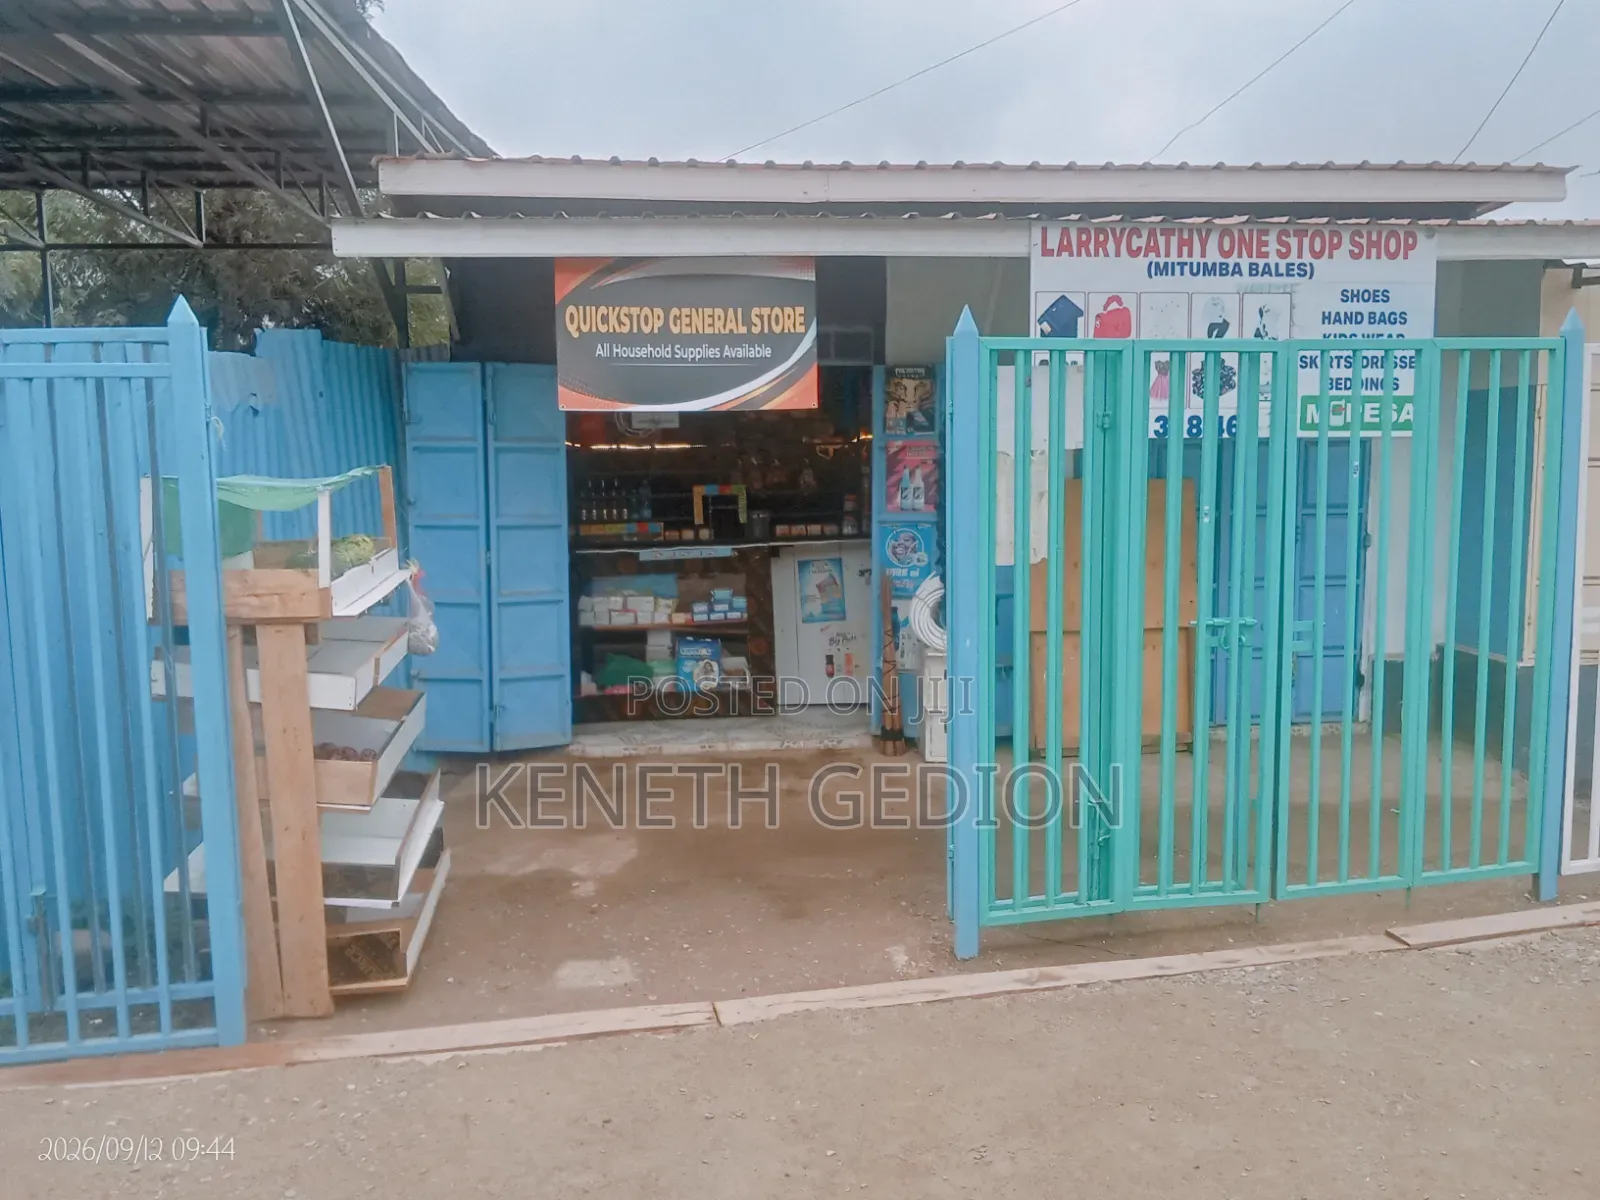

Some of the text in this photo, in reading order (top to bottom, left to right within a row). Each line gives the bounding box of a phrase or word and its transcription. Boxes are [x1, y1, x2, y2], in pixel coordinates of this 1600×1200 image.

[1041, 227, 1418, 260] LARRYCATHY ONE STOP SHOP
[1147, 261, 1315, 280] (MITUMBA BALES)
[1340, 289, 1390, 303] SHOES
[565, 305, 806, 339] QUICKSTOP GENERAL STORE
[1321, 311, 1408, 325] HAND BAGS
[595, 344, 772, 362] All Household Supplies Available
